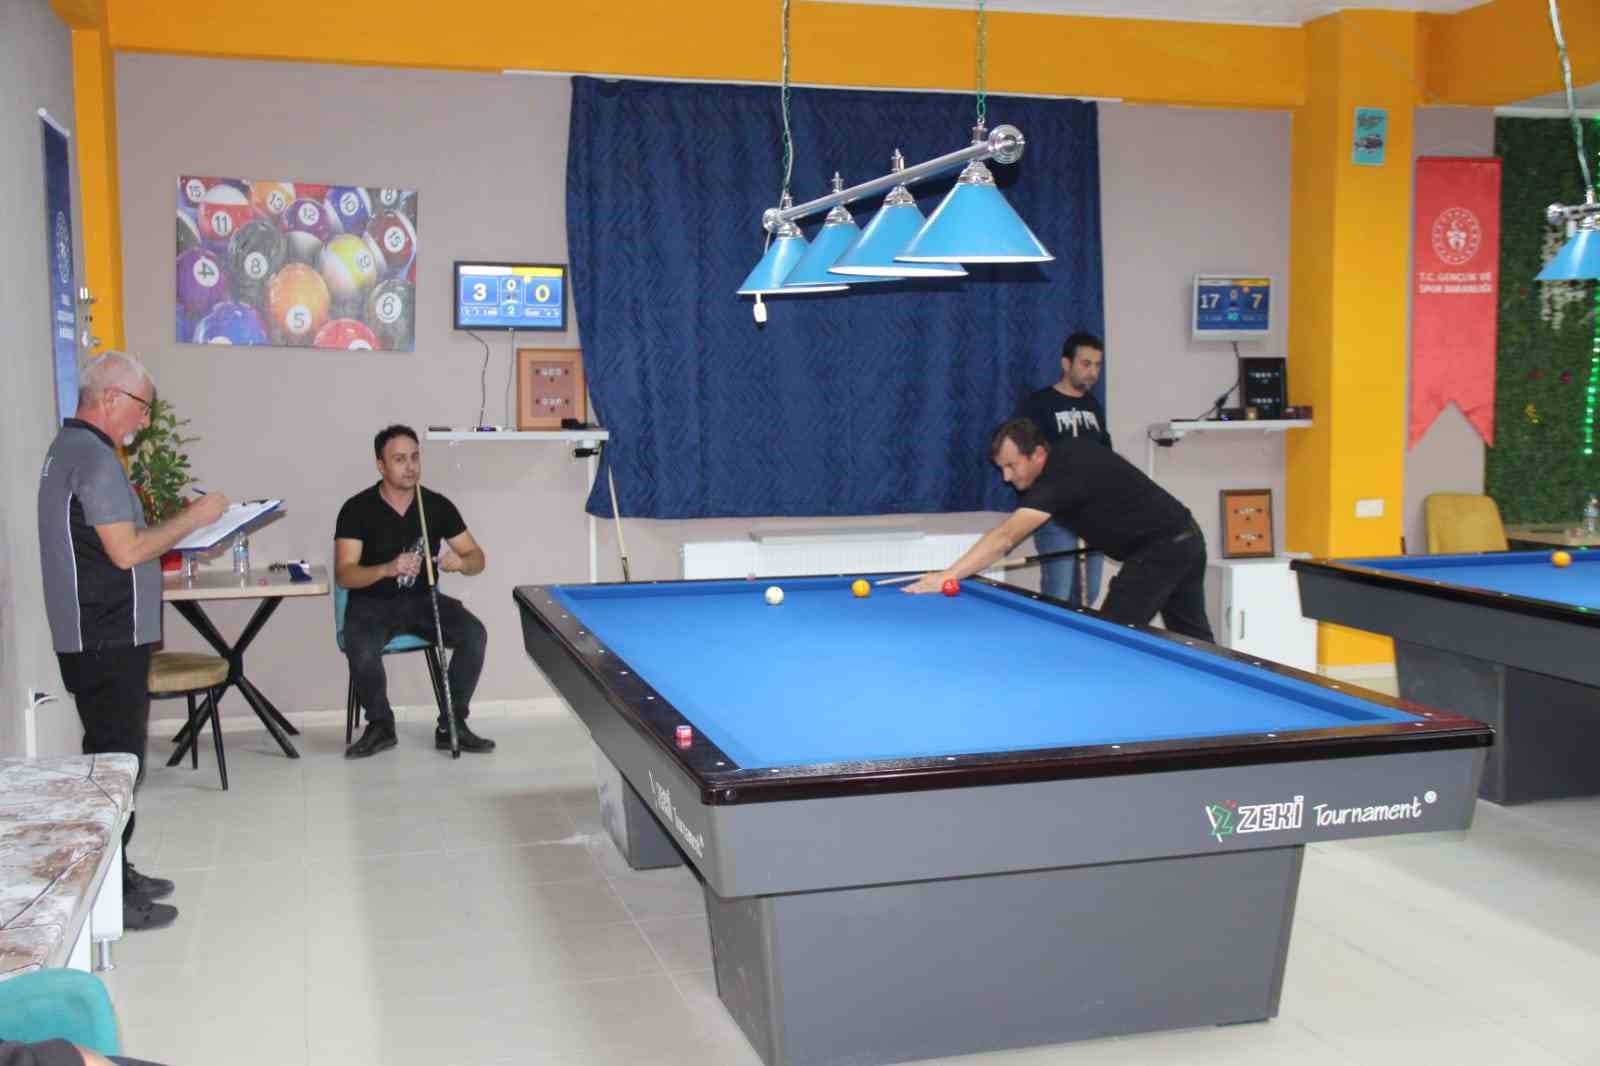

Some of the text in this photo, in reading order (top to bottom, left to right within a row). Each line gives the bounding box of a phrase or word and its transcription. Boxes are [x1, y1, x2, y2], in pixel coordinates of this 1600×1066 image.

[302, 207, 317, 220] 12
[213, 214, 228, 234] 11
[198, 262, 215, 279] 4
[250, 257, 262, 275] 8
[473, 283, 487, 302] 3
[535, 284, 550, 303] 0
[1200, 293, 1221, 309] 17
[1252, 293, 1263, 310] 7
[382, 296, 394, 316] 6
[293, 311, 305, 329] 5
[1313, 796, 1422, 827] Tournament
